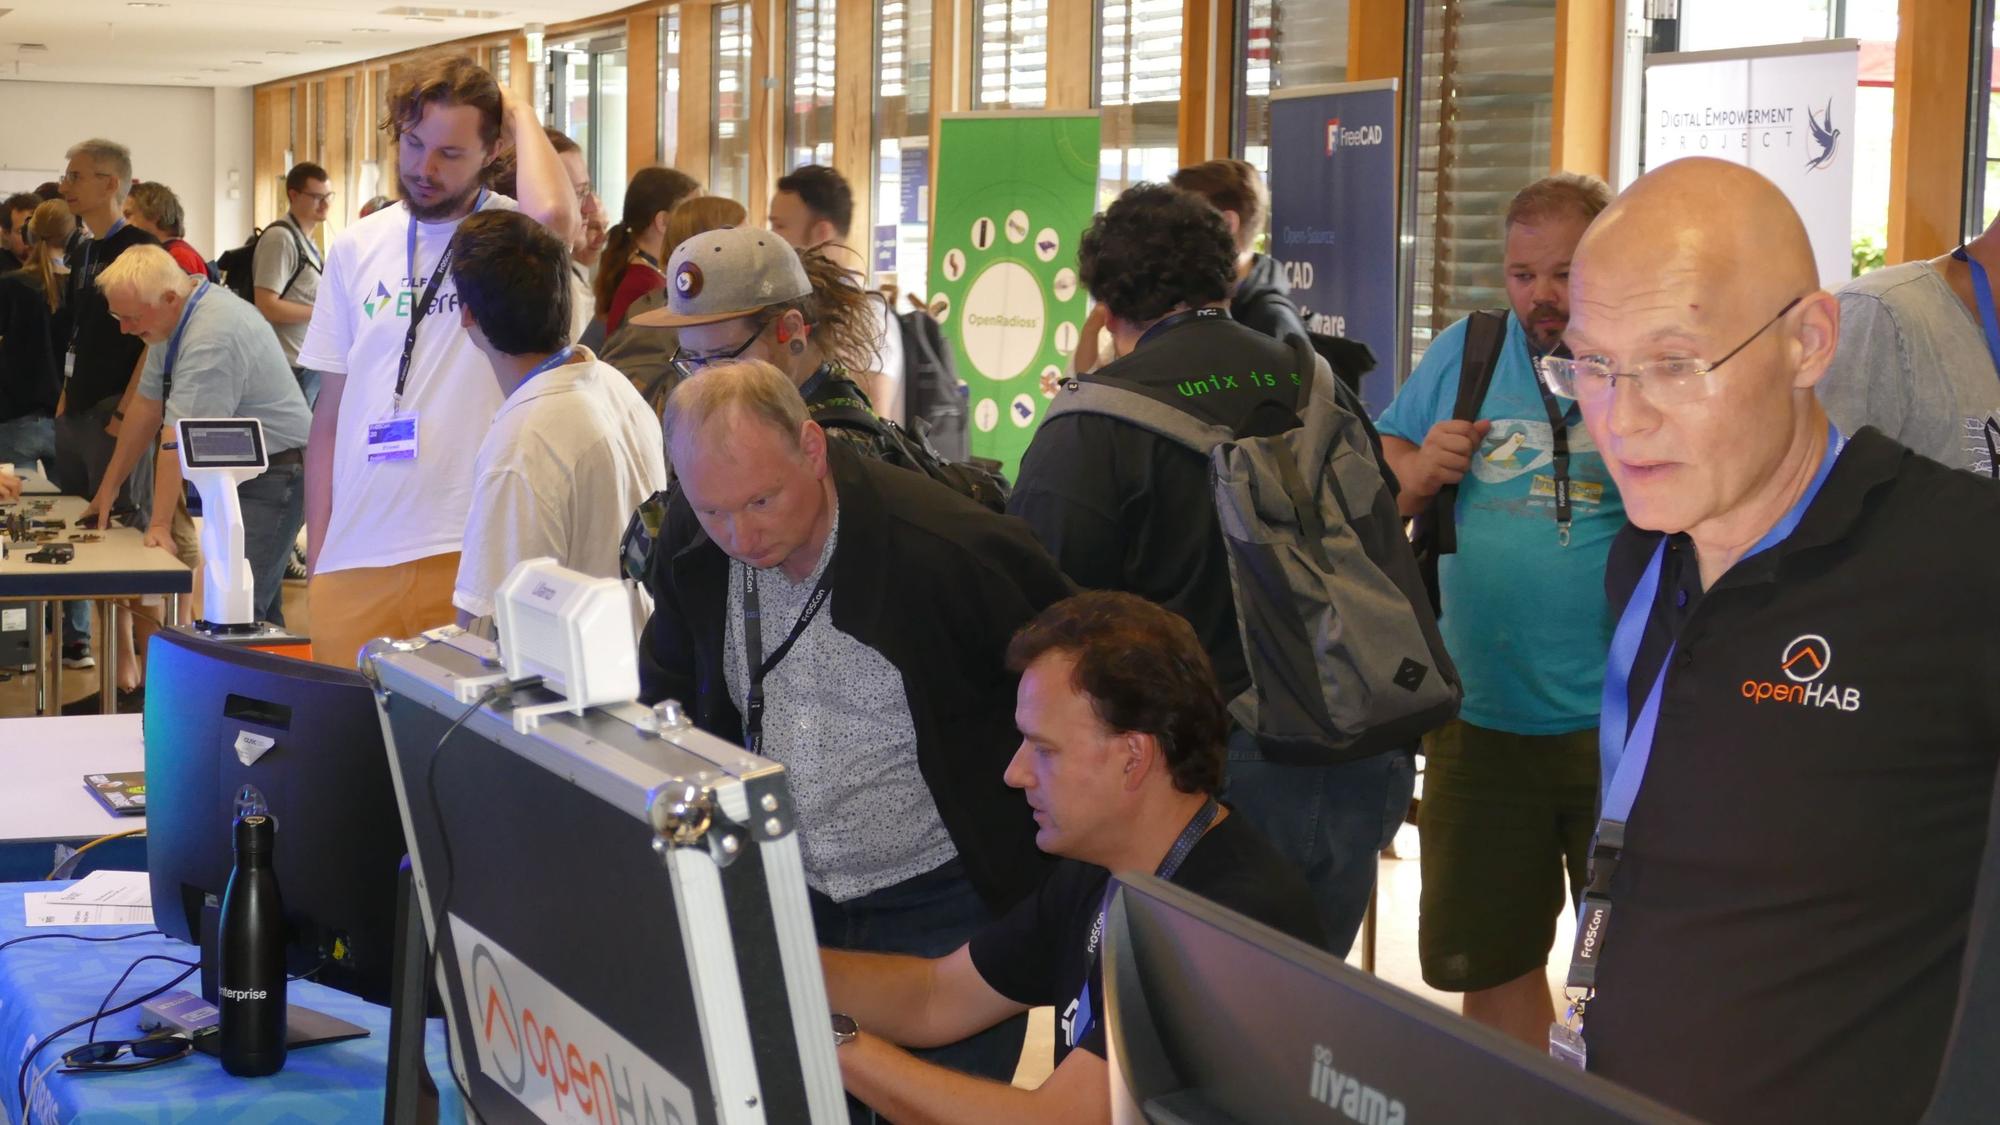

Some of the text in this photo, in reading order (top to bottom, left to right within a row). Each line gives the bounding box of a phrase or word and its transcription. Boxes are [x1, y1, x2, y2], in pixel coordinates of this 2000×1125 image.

[1661, 107, 1794, 127] DIGITAL EMPOWERMENT
[1341, 125, 1383, 146] FreeCAD
[968, 313, 1036, 329] OpenRadioss
[1177, 374, 1239, 397] Unix
[1251, 371, 1277, 387] is
[801, 588, 825, 623] FrOSCon
[1742, 680, 1860, 712] openHAB
[1581, 908, 1604, 958] FrOSCon
[219, 988, 268, 1002] nterprise
[1310, 1044, 1406, 1125] iiyama
